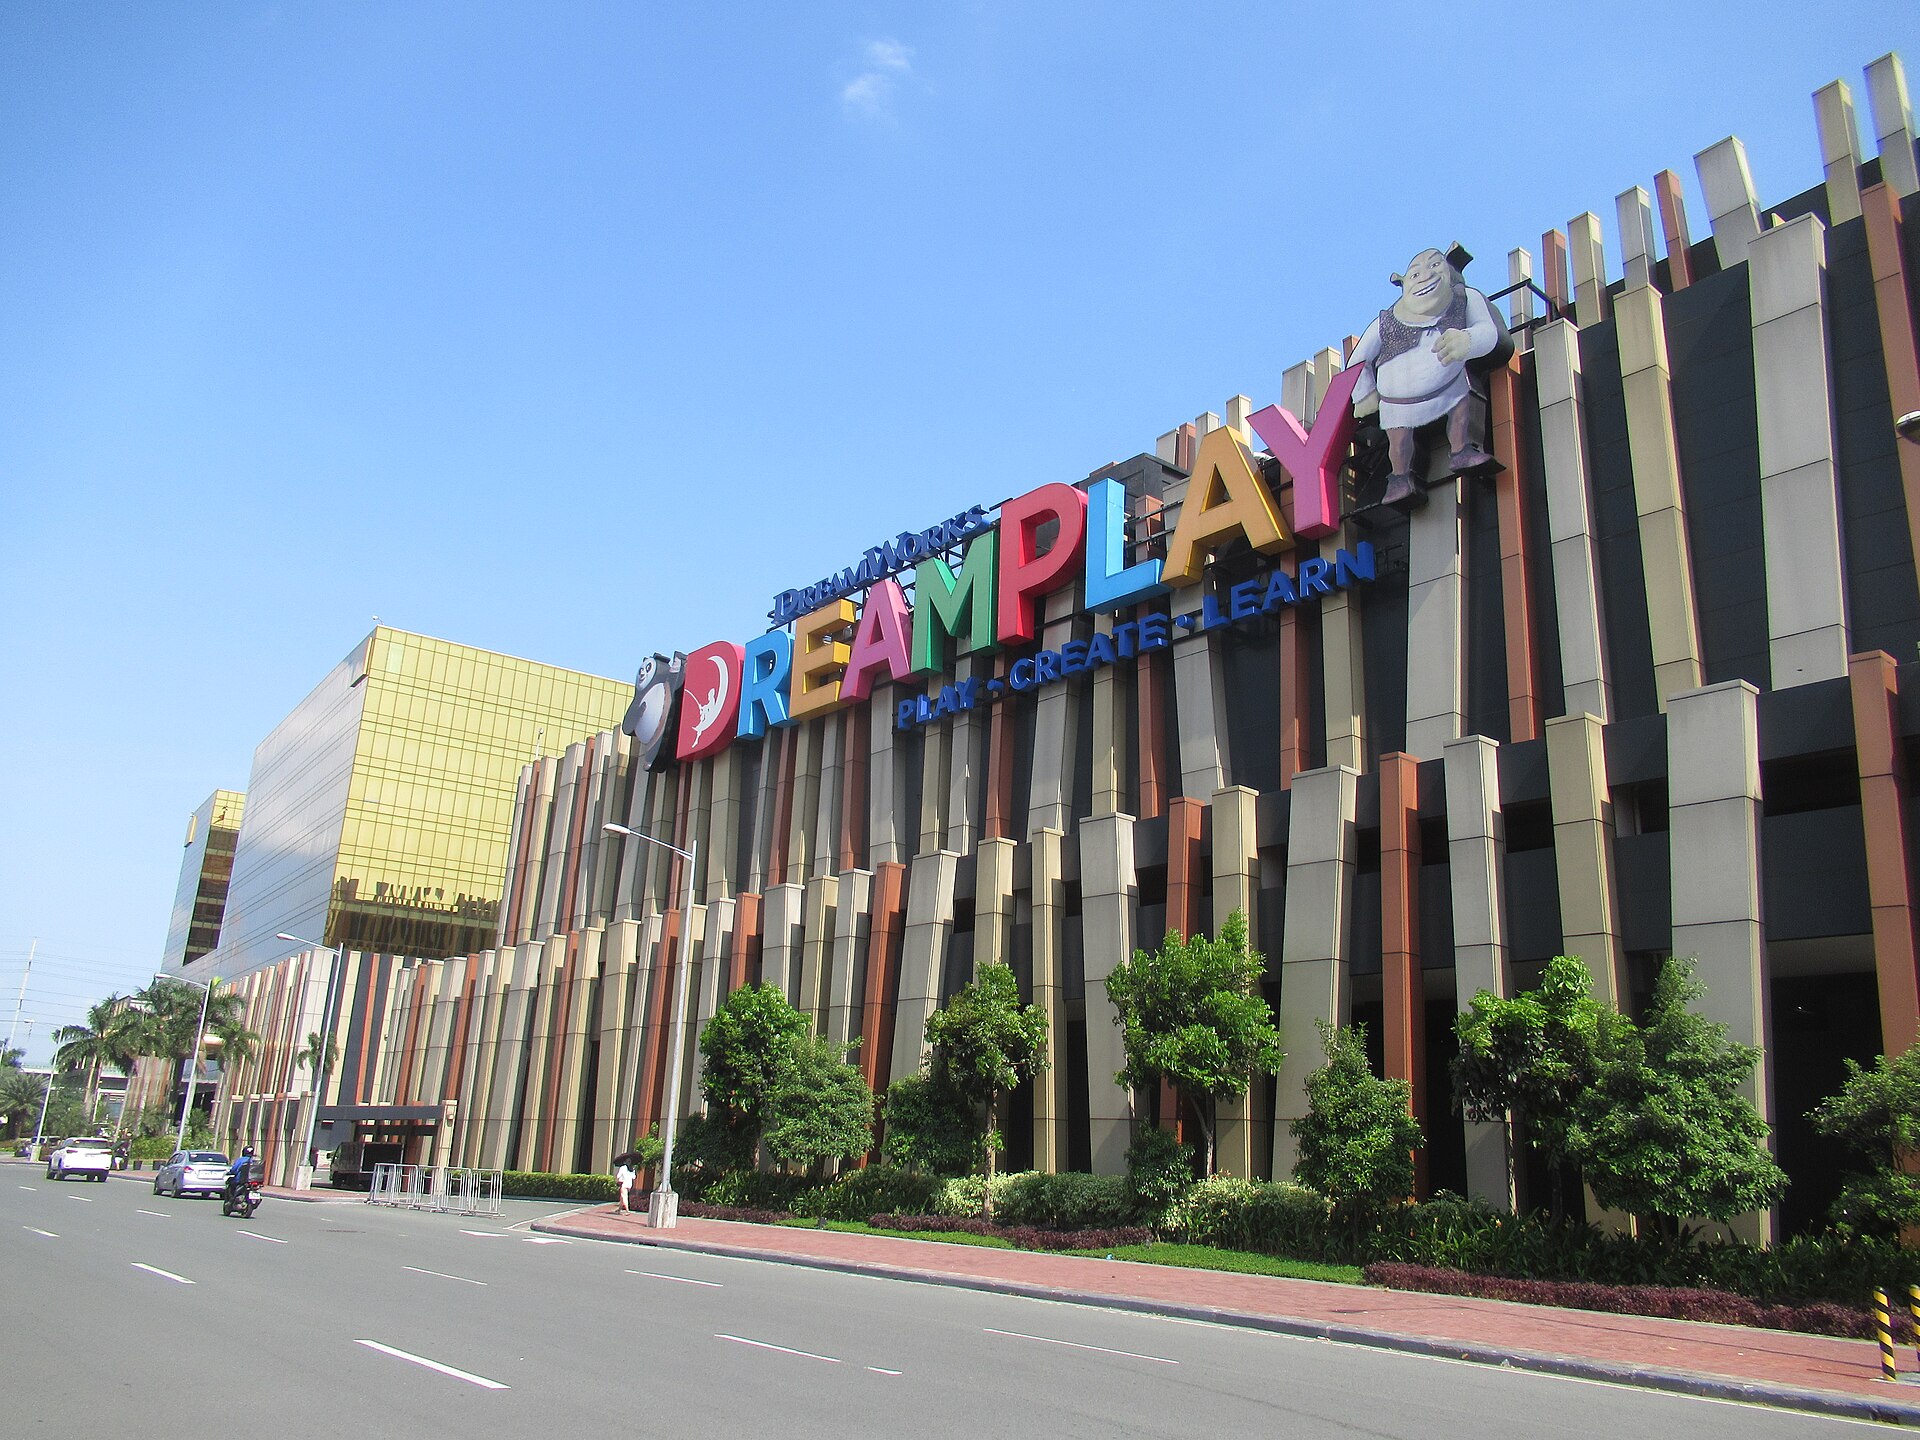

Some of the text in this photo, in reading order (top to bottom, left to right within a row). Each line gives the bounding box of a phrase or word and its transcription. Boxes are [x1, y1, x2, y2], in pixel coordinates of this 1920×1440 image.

[676, 362, 1366, 762] DREAMPLAY
[767, 504, 991, 625] DREAMWORKS
[898, 541, 1376, 730] PLAY CREATE LEARN
